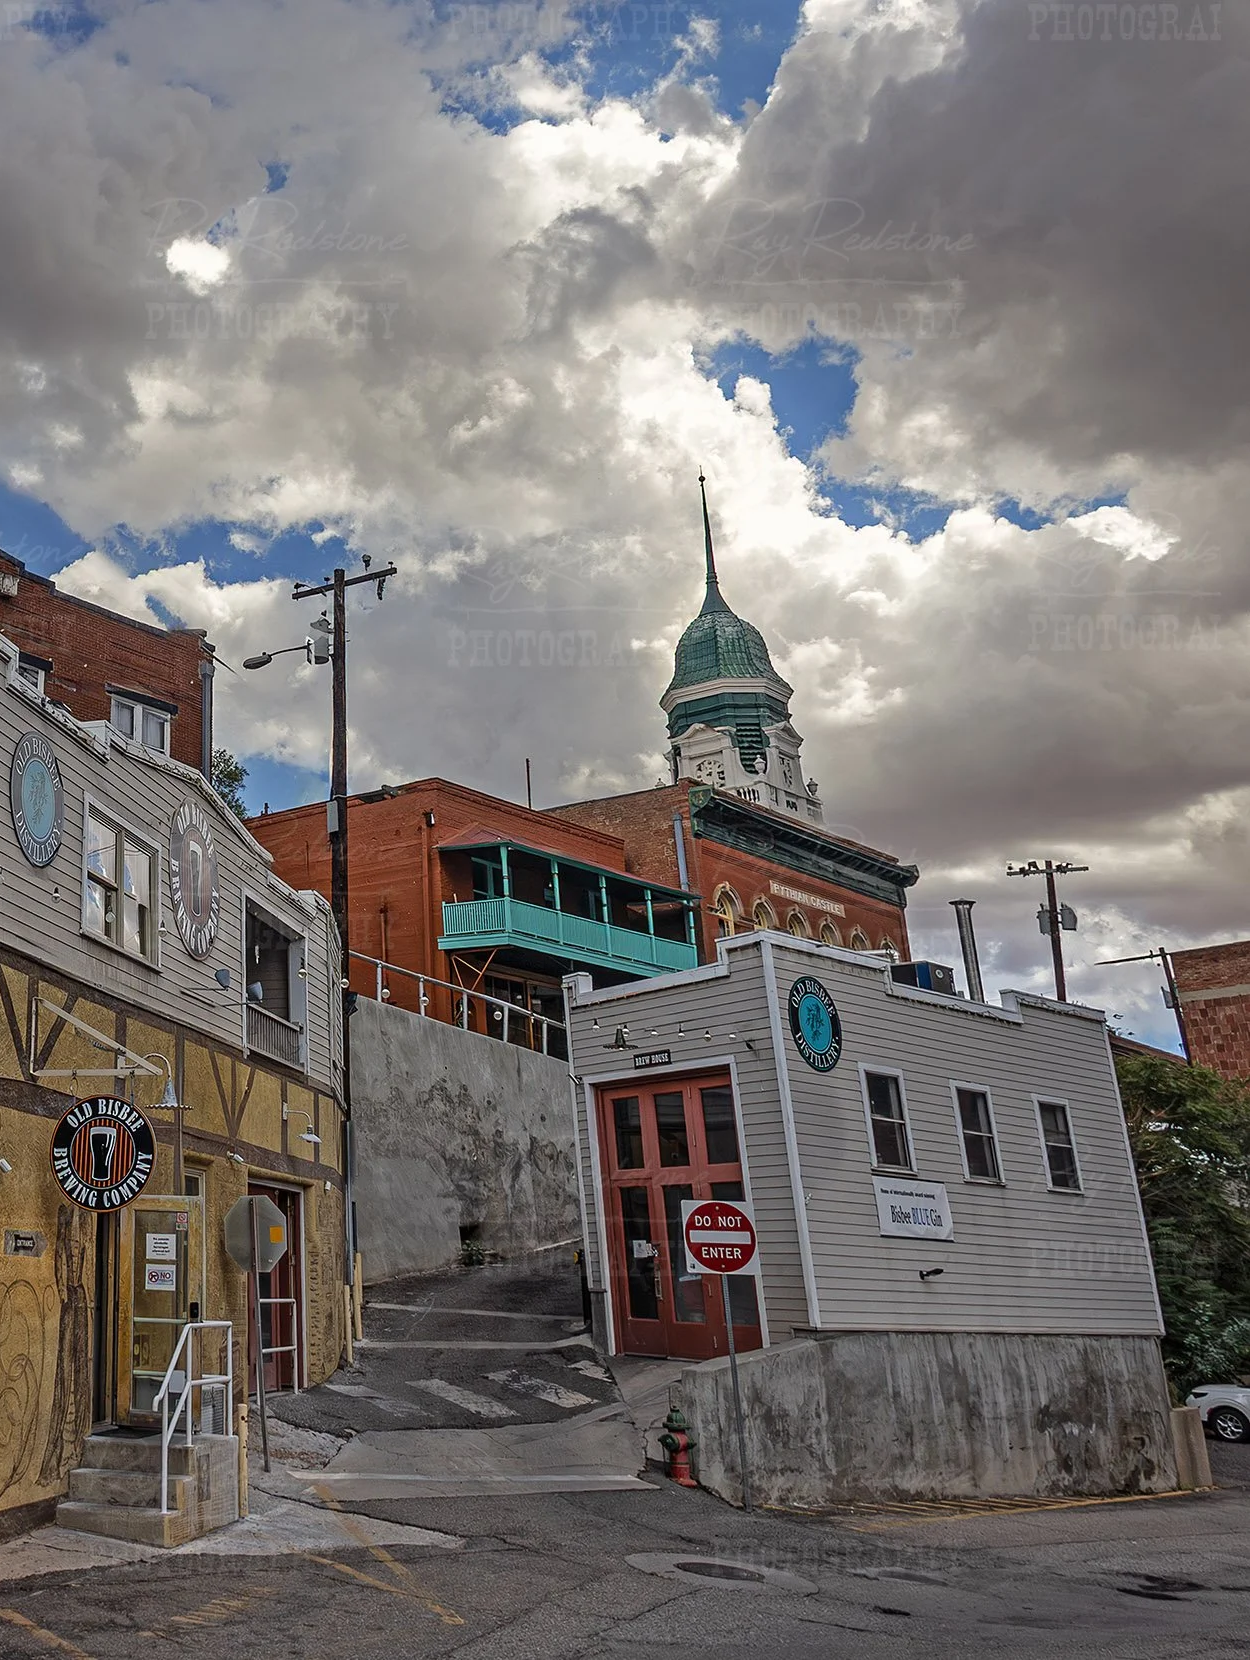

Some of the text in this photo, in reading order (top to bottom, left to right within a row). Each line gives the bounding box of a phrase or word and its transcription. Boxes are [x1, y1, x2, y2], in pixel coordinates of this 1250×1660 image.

[15, 738, 62, 791] OLD BISBEE
[810, 896, 842, 915] CASTLE
[791, 980, 836, 1017] OLD BISBEE
[66, 1099, 145, 1132] OLD BISBEE
[54, 1147, 153, 1208] BREWING COMPANY
[695, 1215, 742, 1228] DO NOT
[890, 1205, 943, 1227] Bisbee BLUE Gin
[702, 1247, 742, 1259] ENTER
[160, 1272, 171, 1280] NO
